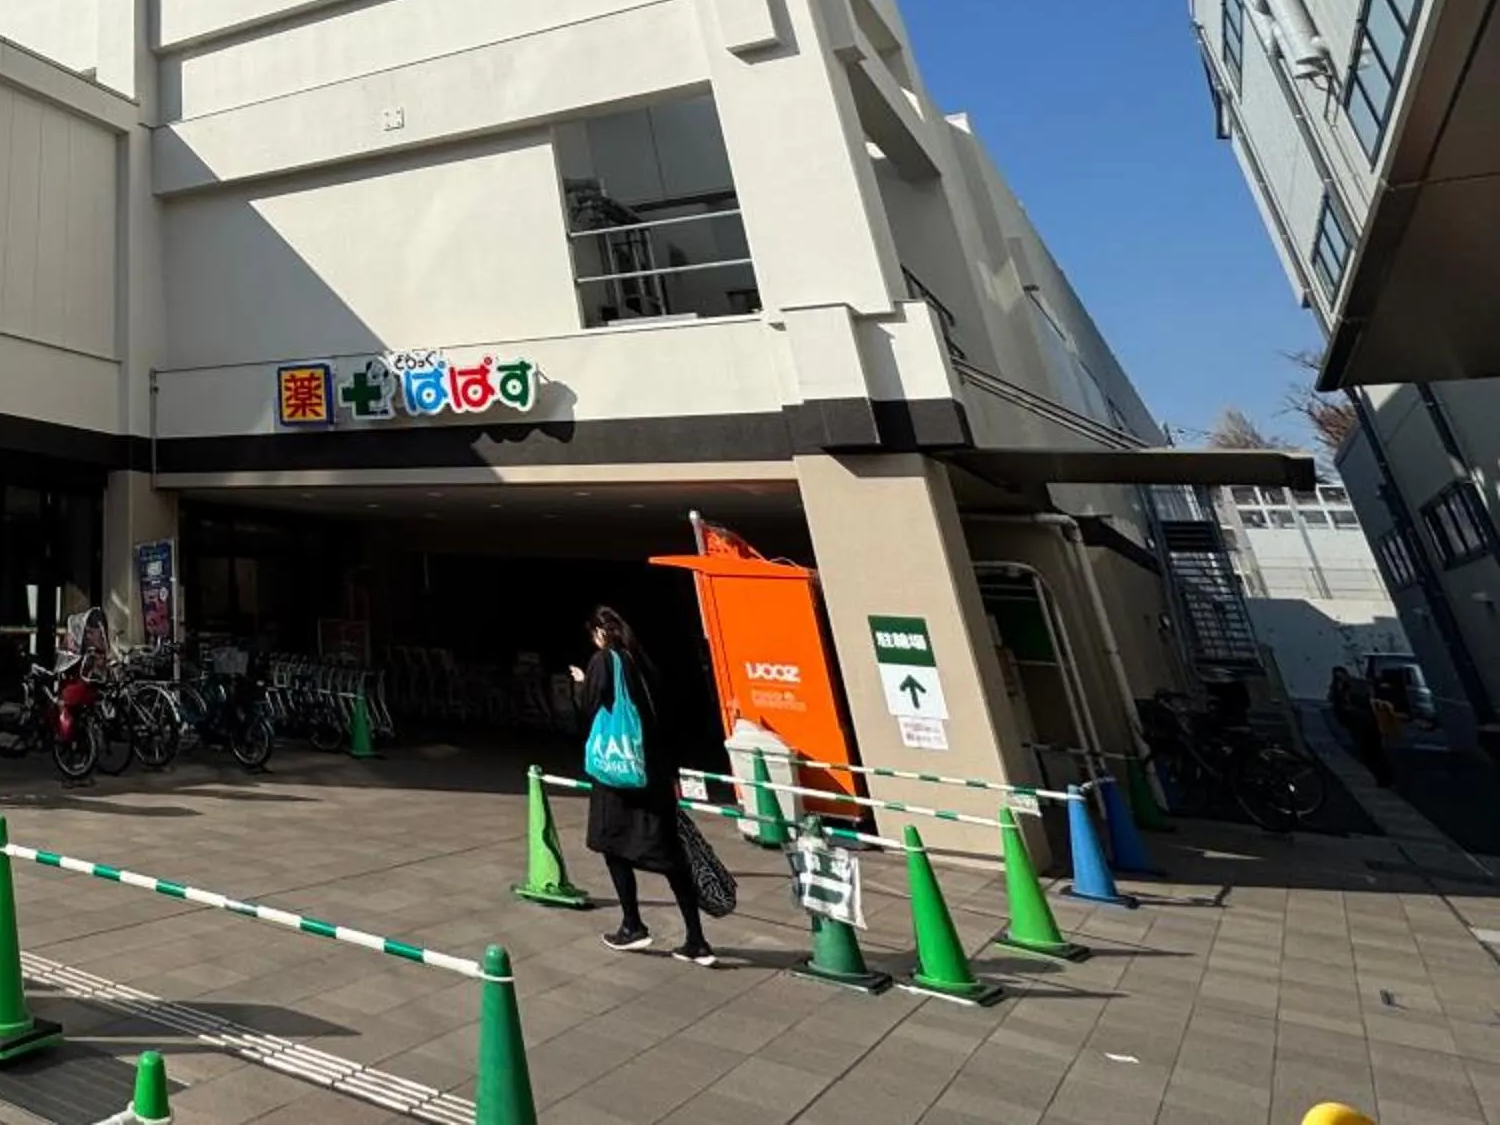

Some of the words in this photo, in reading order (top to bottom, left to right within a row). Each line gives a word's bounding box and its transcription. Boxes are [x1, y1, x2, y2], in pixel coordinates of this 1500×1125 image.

[284, 371, 324, 418] 薬
[403, 356, 533, 412] ぱぱす
